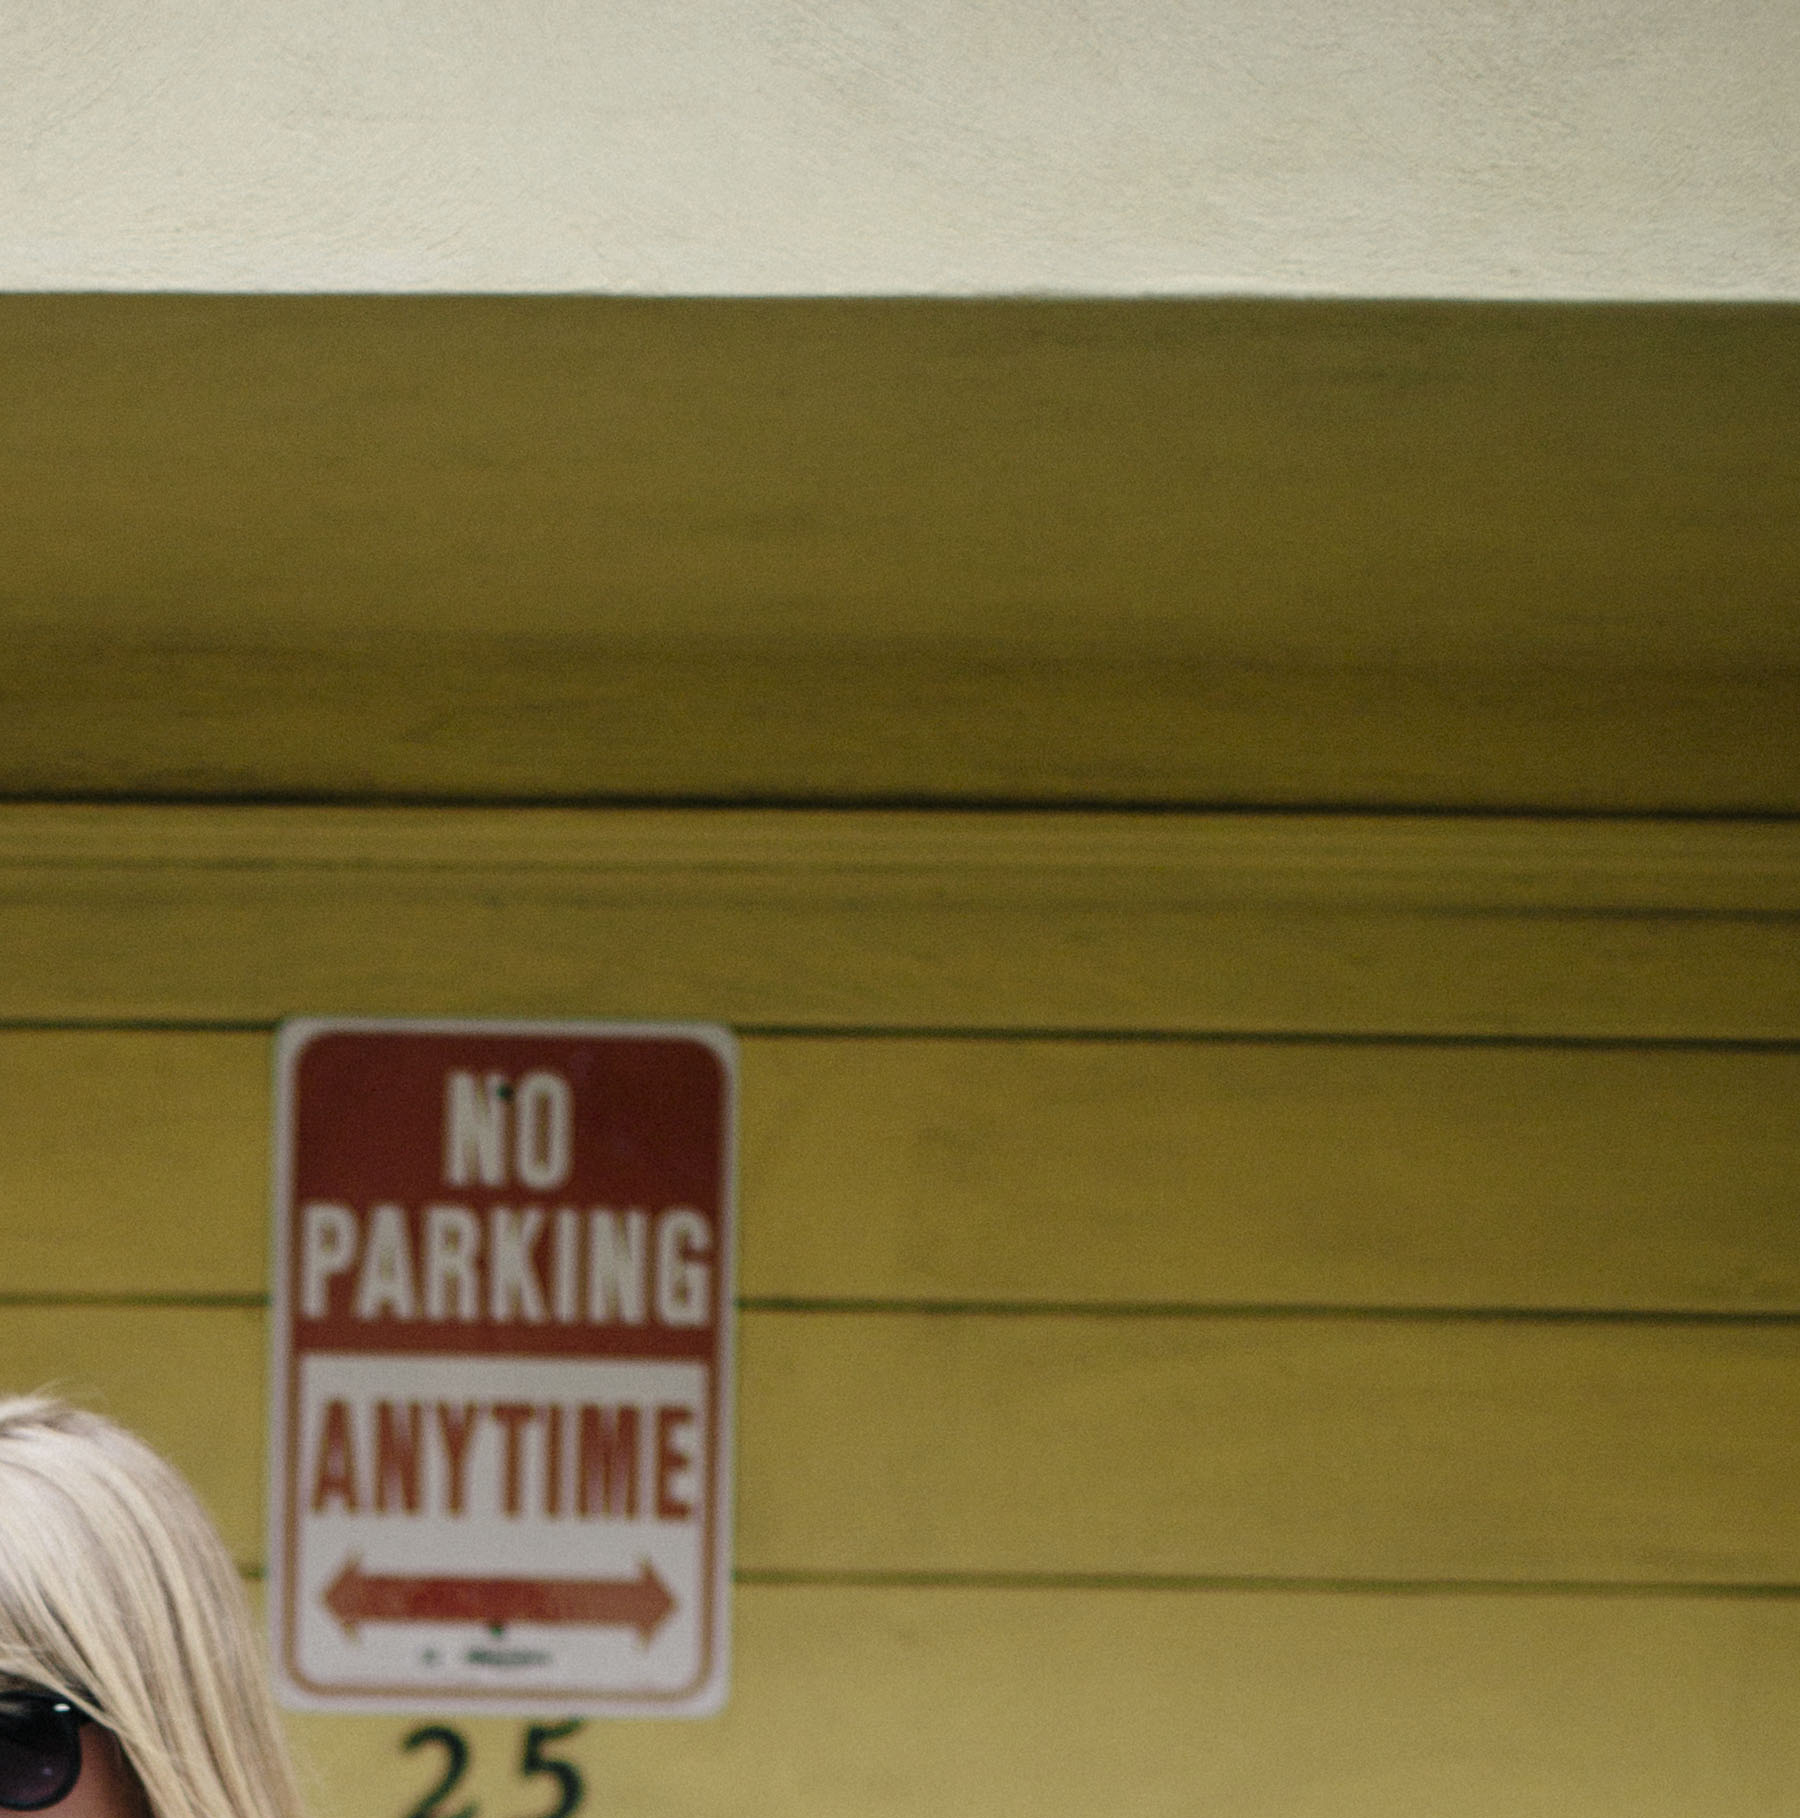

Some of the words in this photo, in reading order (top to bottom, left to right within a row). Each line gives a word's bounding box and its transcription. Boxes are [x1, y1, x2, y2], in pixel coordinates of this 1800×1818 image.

[448, 1070, 573, 1191] NO
[302, 1203, 712, 1327] PARKING
[311, 1399, 695, 1521] ANYTIME
